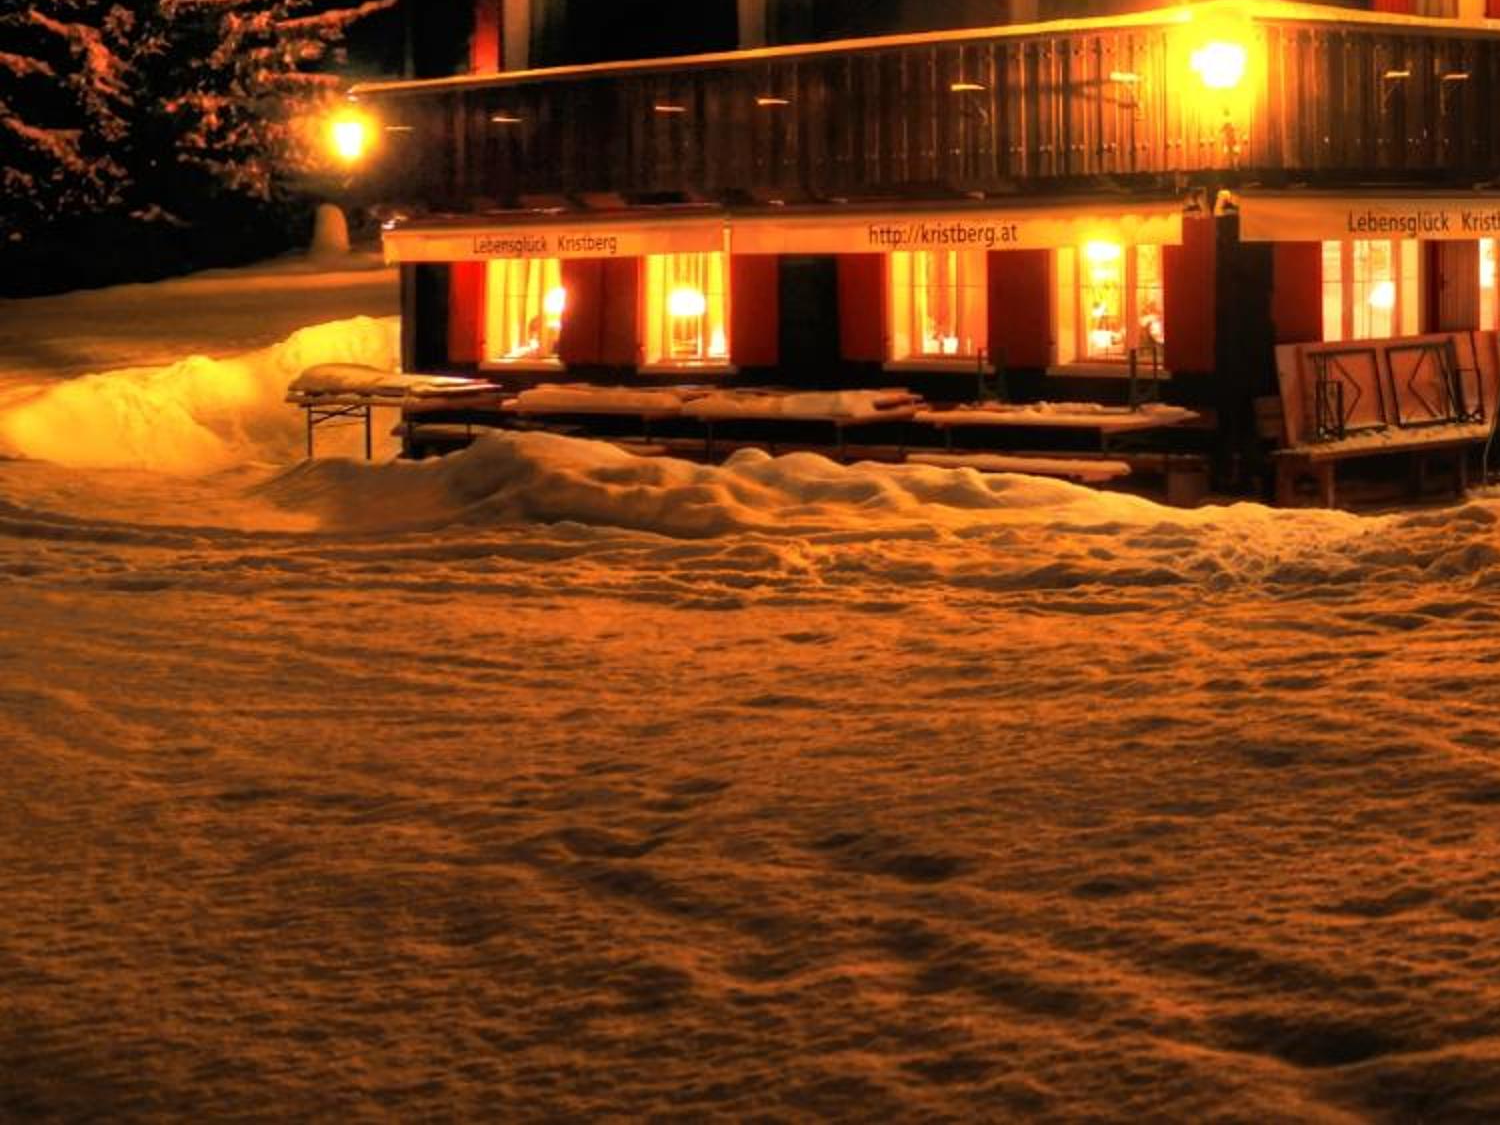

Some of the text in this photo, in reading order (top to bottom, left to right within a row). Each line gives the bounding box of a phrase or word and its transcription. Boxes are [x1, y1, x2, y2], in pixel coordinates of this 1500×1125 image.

[868, 222, 1019, 249] http://kristberg.at
[1348, 210, 1449, 237] Lebensglück
[557, 234, 617, 254] Kristberg
